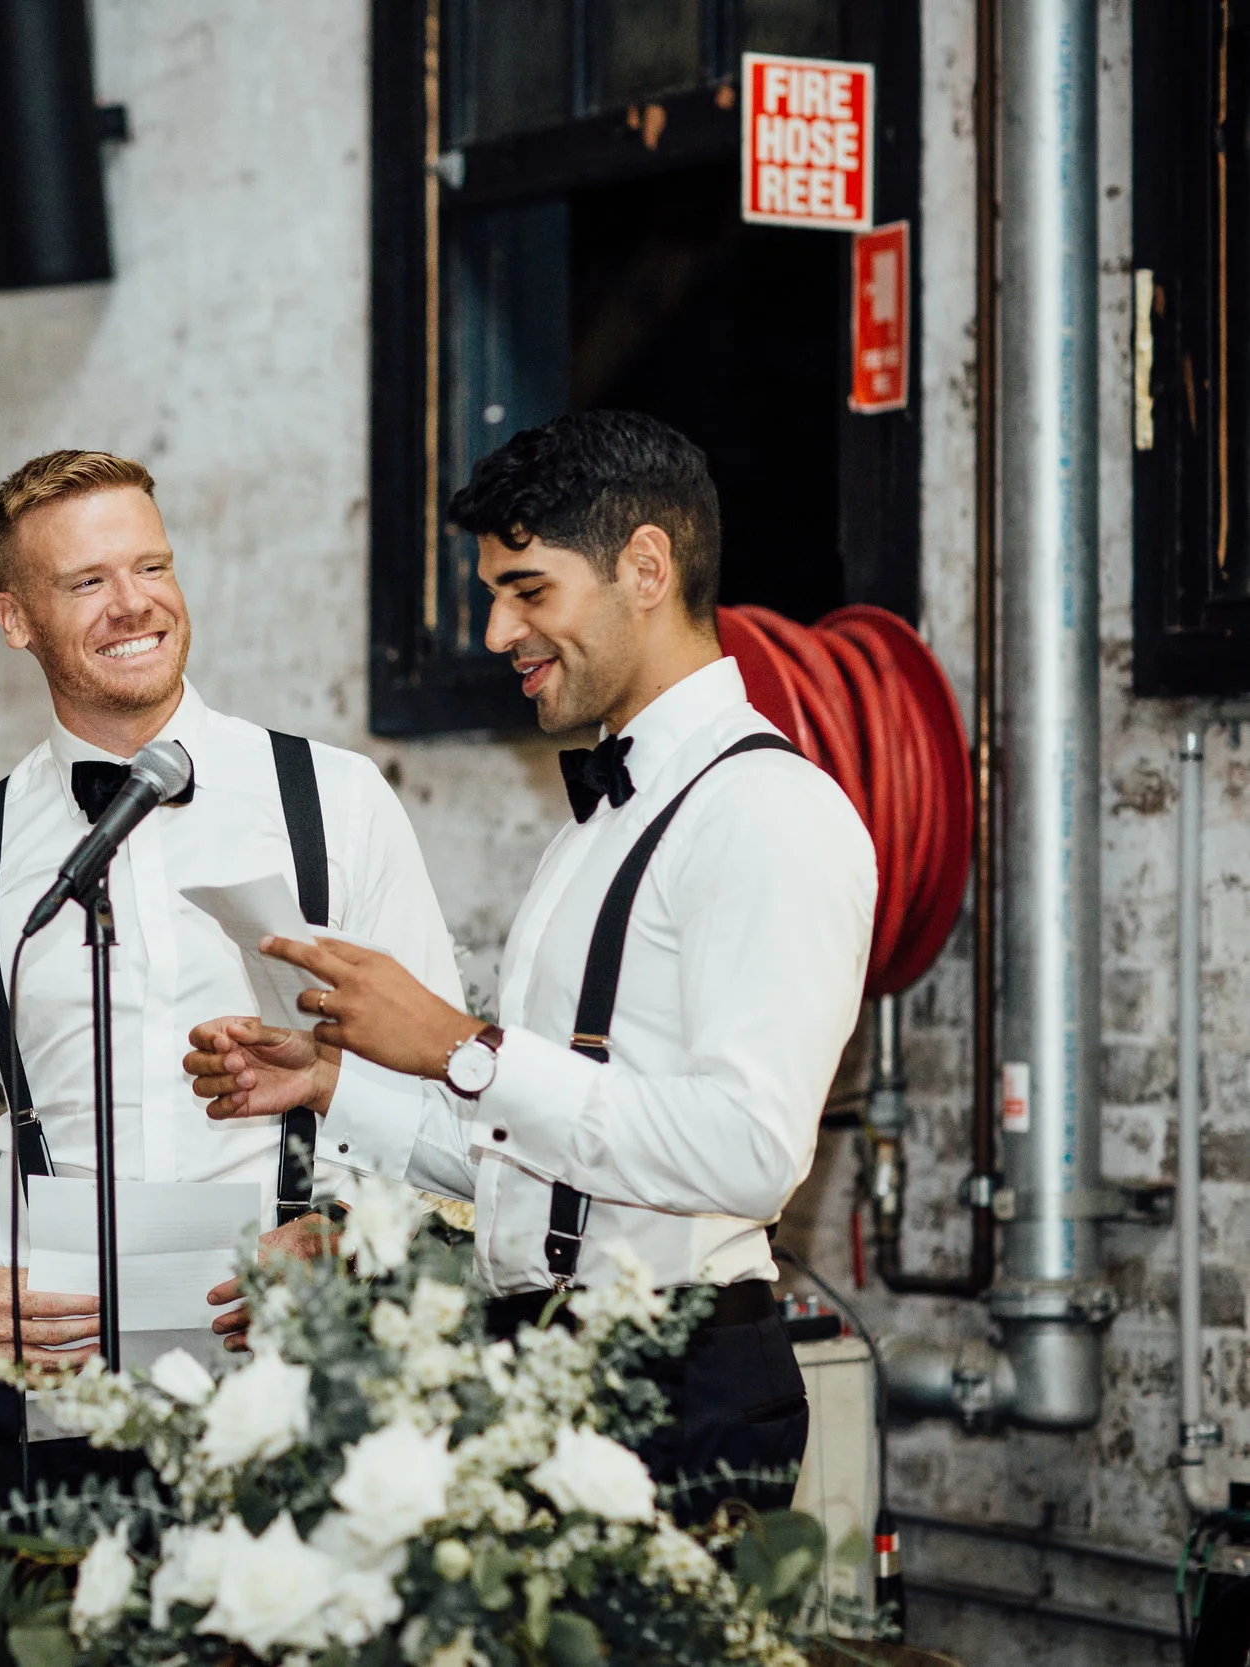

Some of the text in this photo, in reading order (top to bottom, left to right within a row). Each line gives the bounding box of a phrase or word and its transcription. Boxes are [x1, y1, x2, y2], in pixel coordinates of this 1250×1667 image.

[763, 66, 853, 119] FIRE
[757, 114, 859, 171] HOSE
[759, 165, 856, 217] REEL
